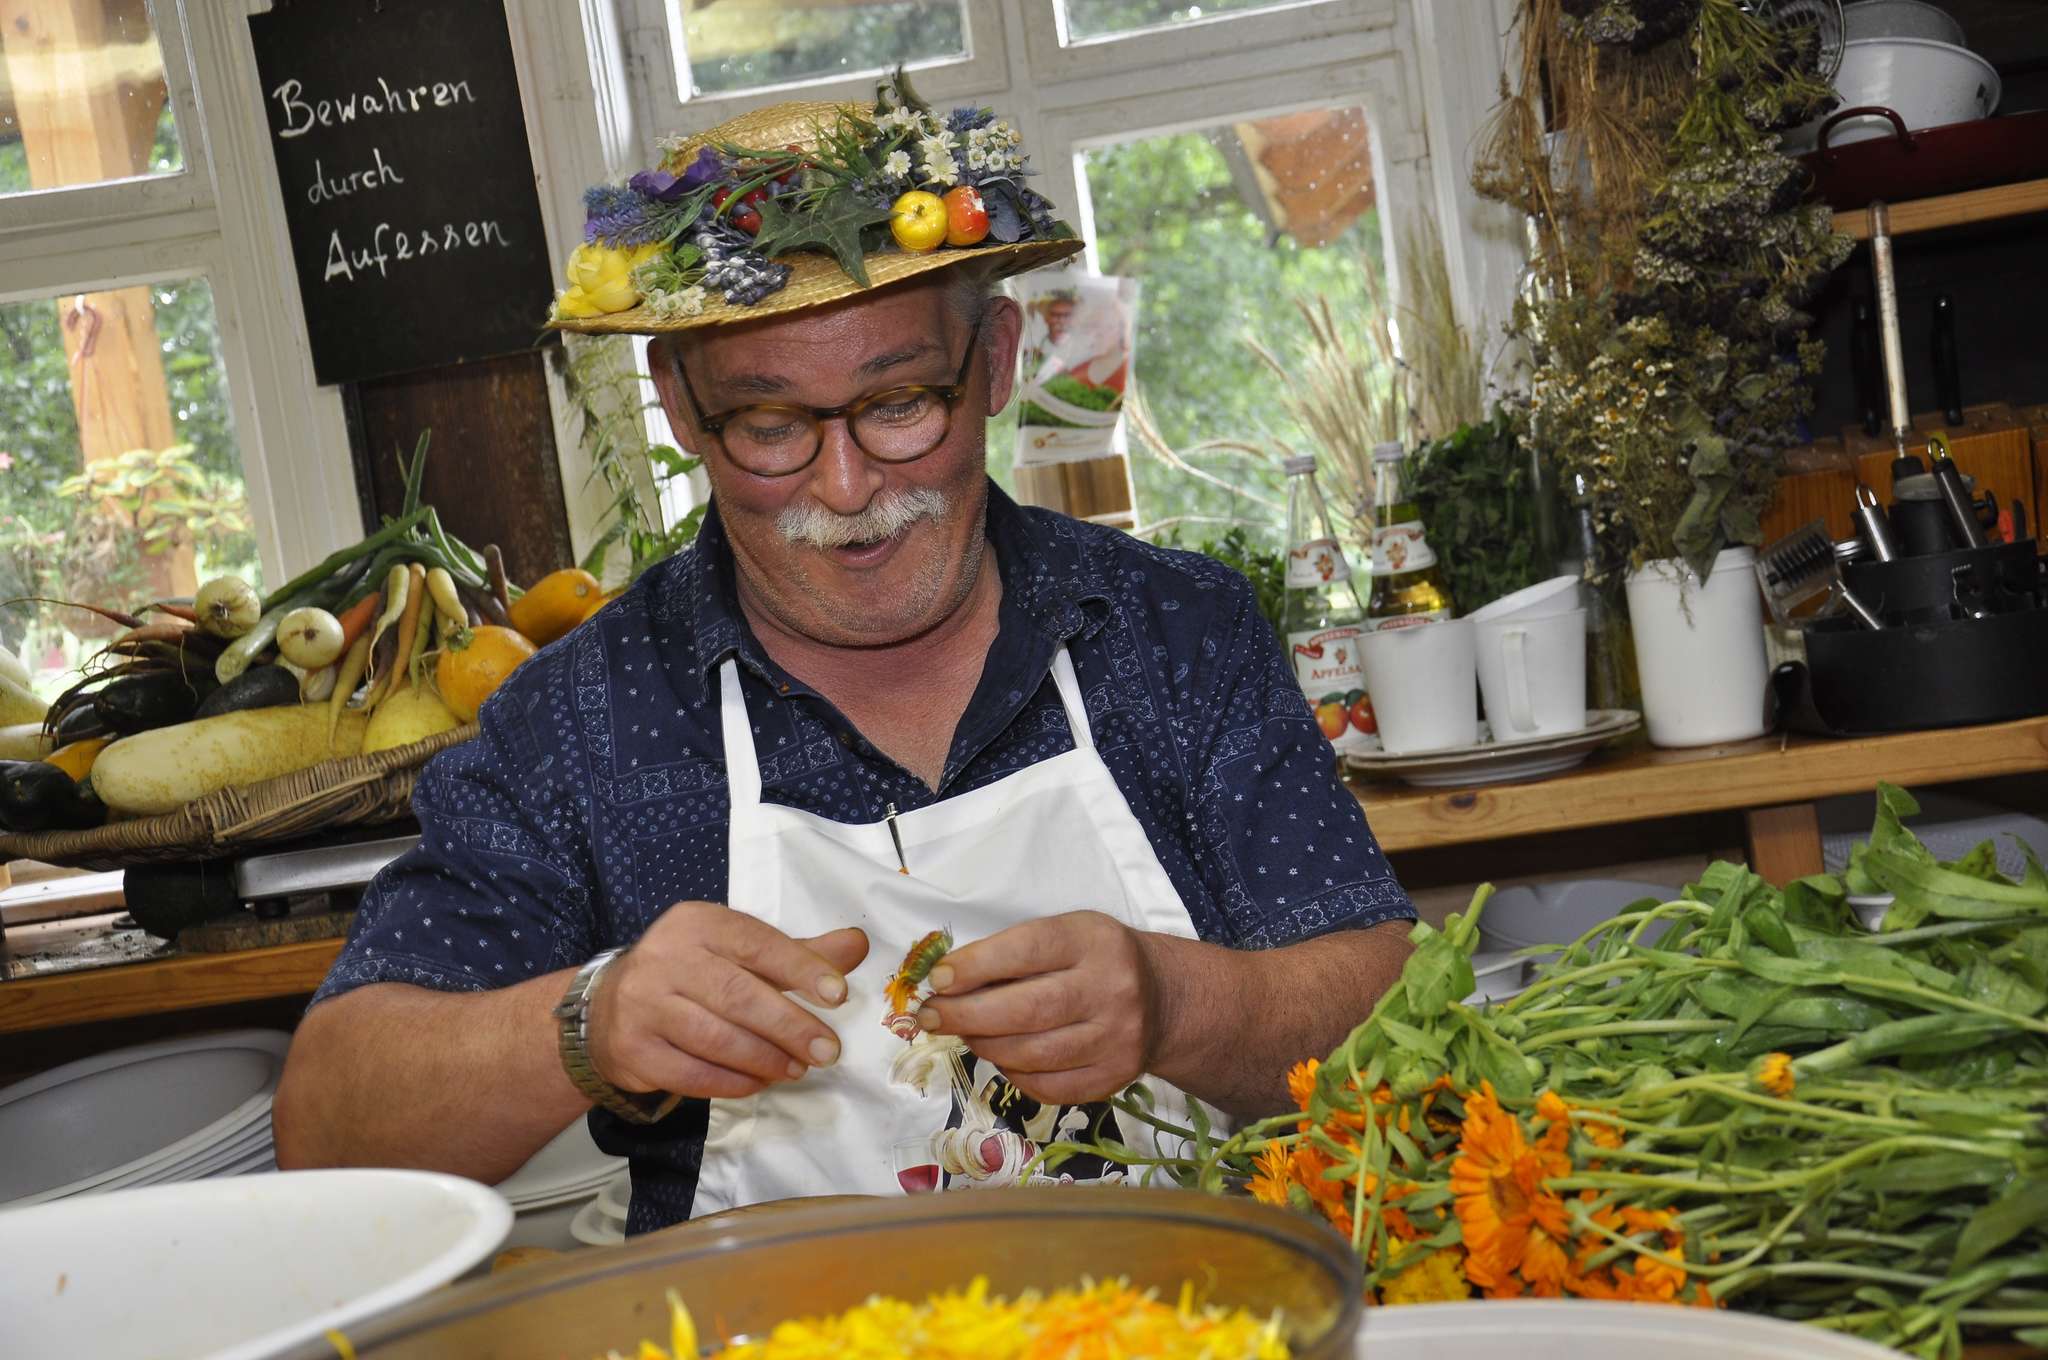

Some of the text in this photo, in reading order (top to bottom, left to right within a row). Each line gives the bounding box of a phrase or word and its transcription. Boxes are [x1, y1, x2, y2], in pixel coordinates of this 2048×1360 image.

[272, 77, 476, 138] Bewahren
[308, 147, 404, 204] durch
[324, 220, 511, 282] Aufessen
